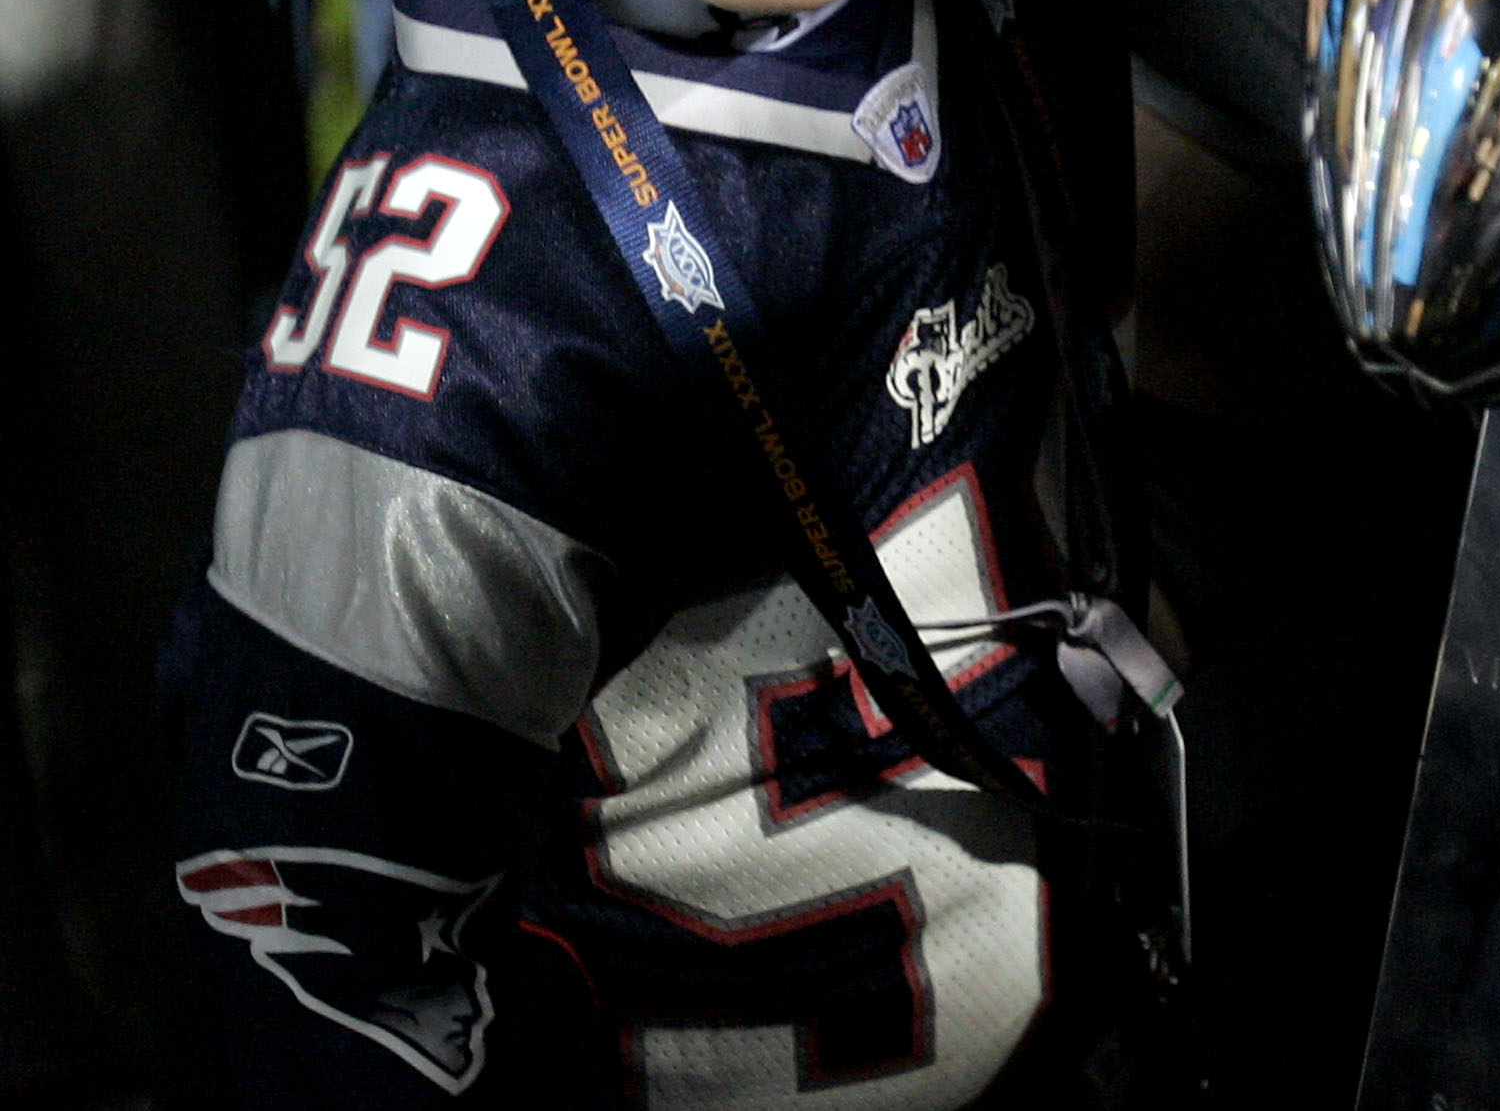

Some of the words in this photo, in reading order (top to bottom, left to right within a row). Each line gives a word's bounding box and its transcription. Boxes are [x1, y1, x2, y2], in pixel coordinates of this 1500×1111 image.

[546, 15, 602, 104] BOWL
[591, 104, 660, 207] SUPER
[262, 150, 512, 401] 52
[701, 317, 761, 410] XXXIX
[755, 408, 806, 502] BOWL
[797, 501, 855, 594] SUPER
